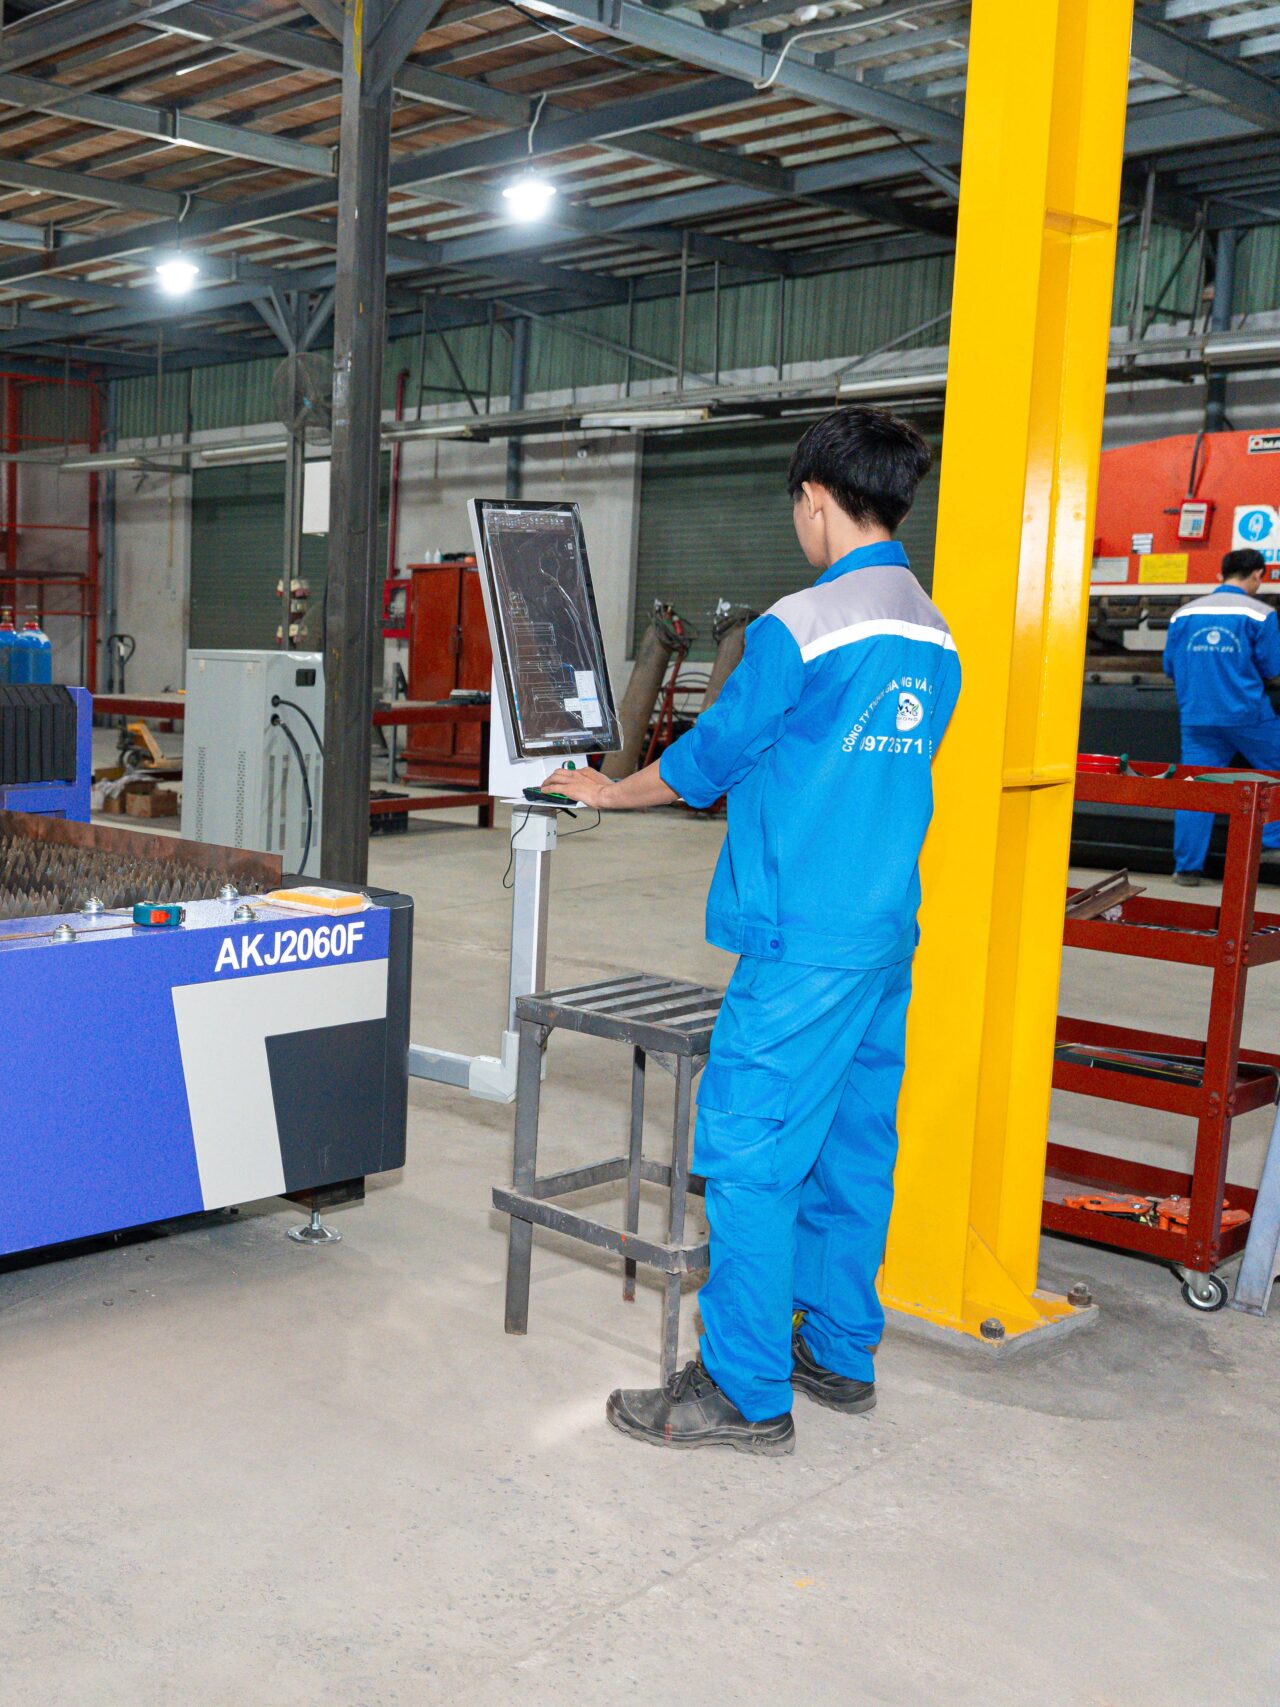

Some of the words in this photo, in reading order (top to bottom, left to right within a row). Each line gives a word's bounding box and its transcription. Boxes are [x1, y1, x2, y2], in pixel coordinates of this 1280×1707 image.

[842, 724, 863, 752] CÔNG
[859, 710, 870, 723] TY
[915, 677, 927, 692] VÀ
[214, 921, 365, 972] AKJ2060F
